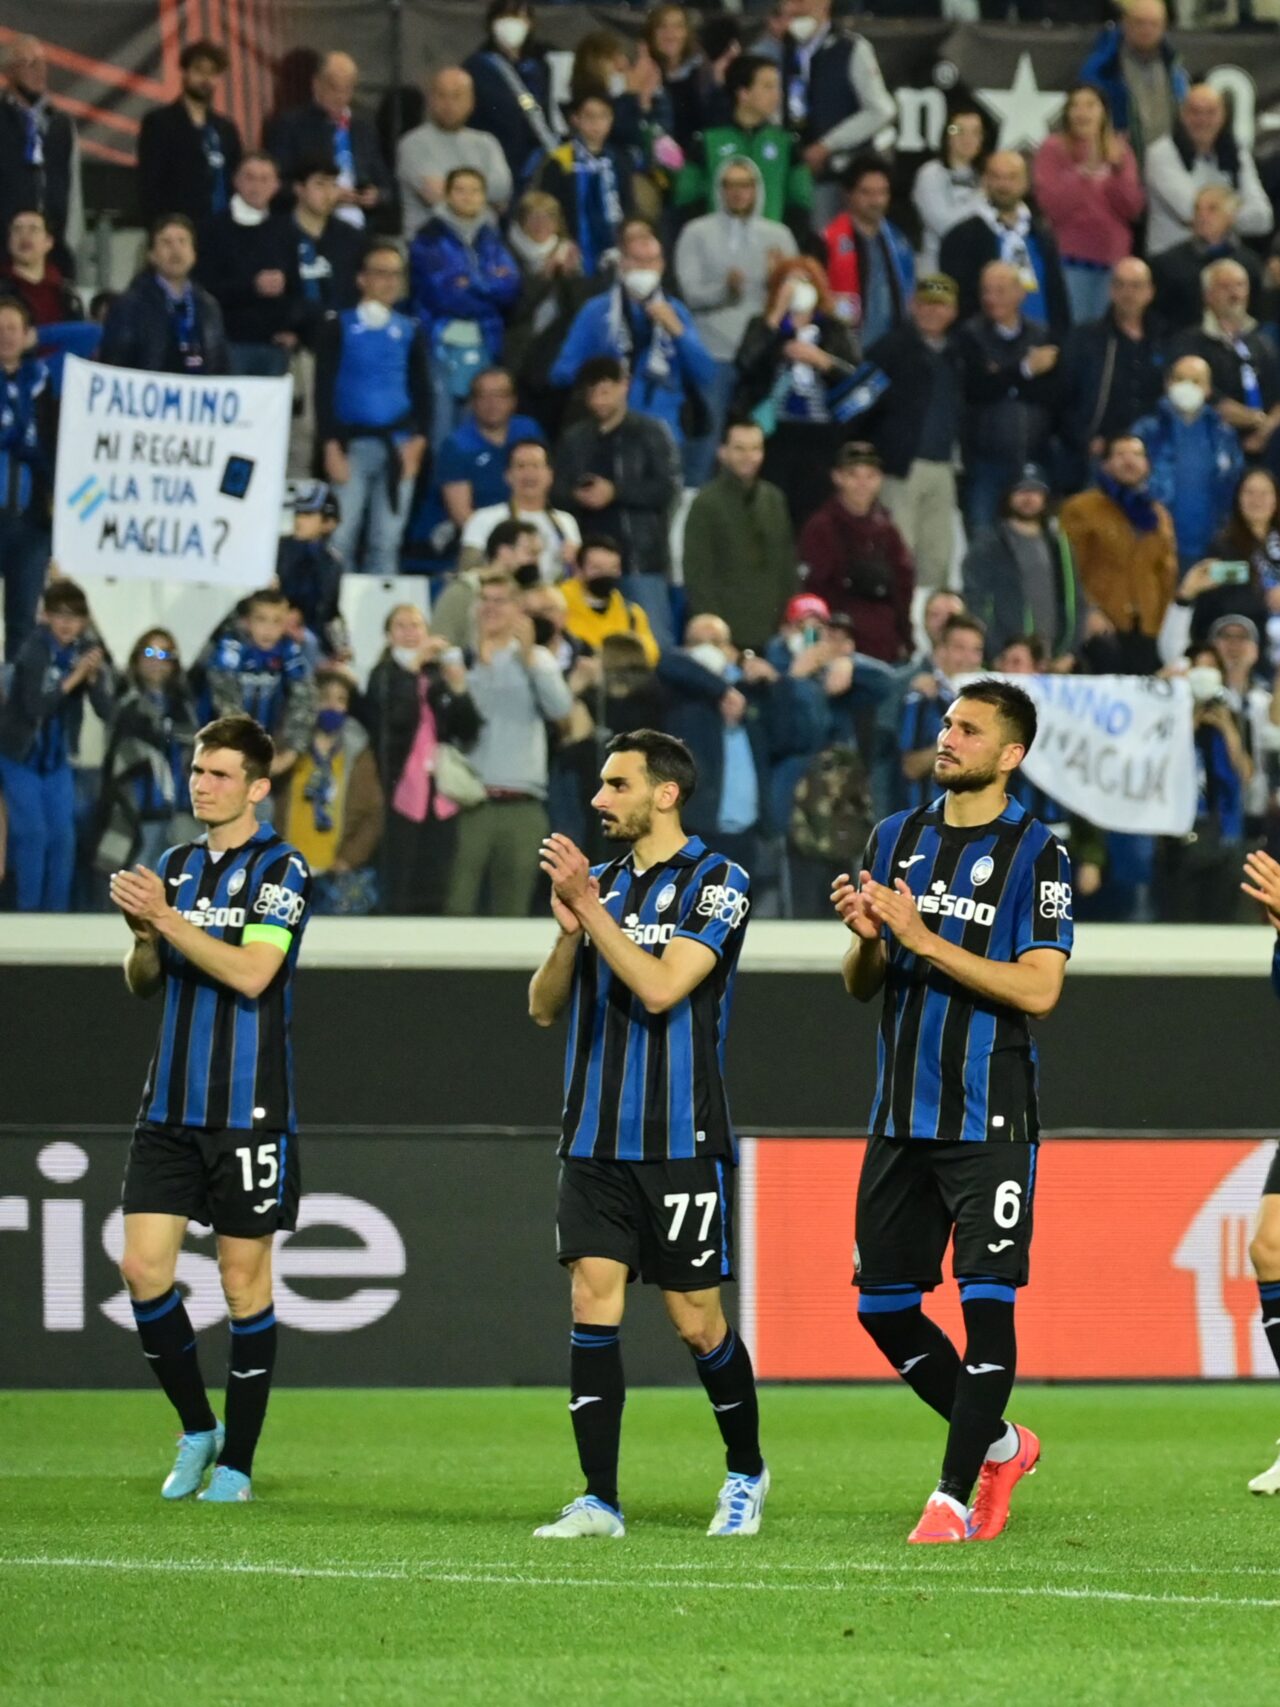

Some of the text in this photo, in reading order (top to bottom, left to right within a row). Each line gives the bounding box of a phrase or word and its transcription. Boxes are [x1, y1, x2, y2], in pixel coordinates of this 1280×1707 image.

[94, 430, 216, 468] MI REGALI
[108, 473, 197, 506] LA TUA
[236, 1143, 279, 1191] 15
[664, 1191, 718, 1241] 77
[993, 1180, 1022, 1229] 6
